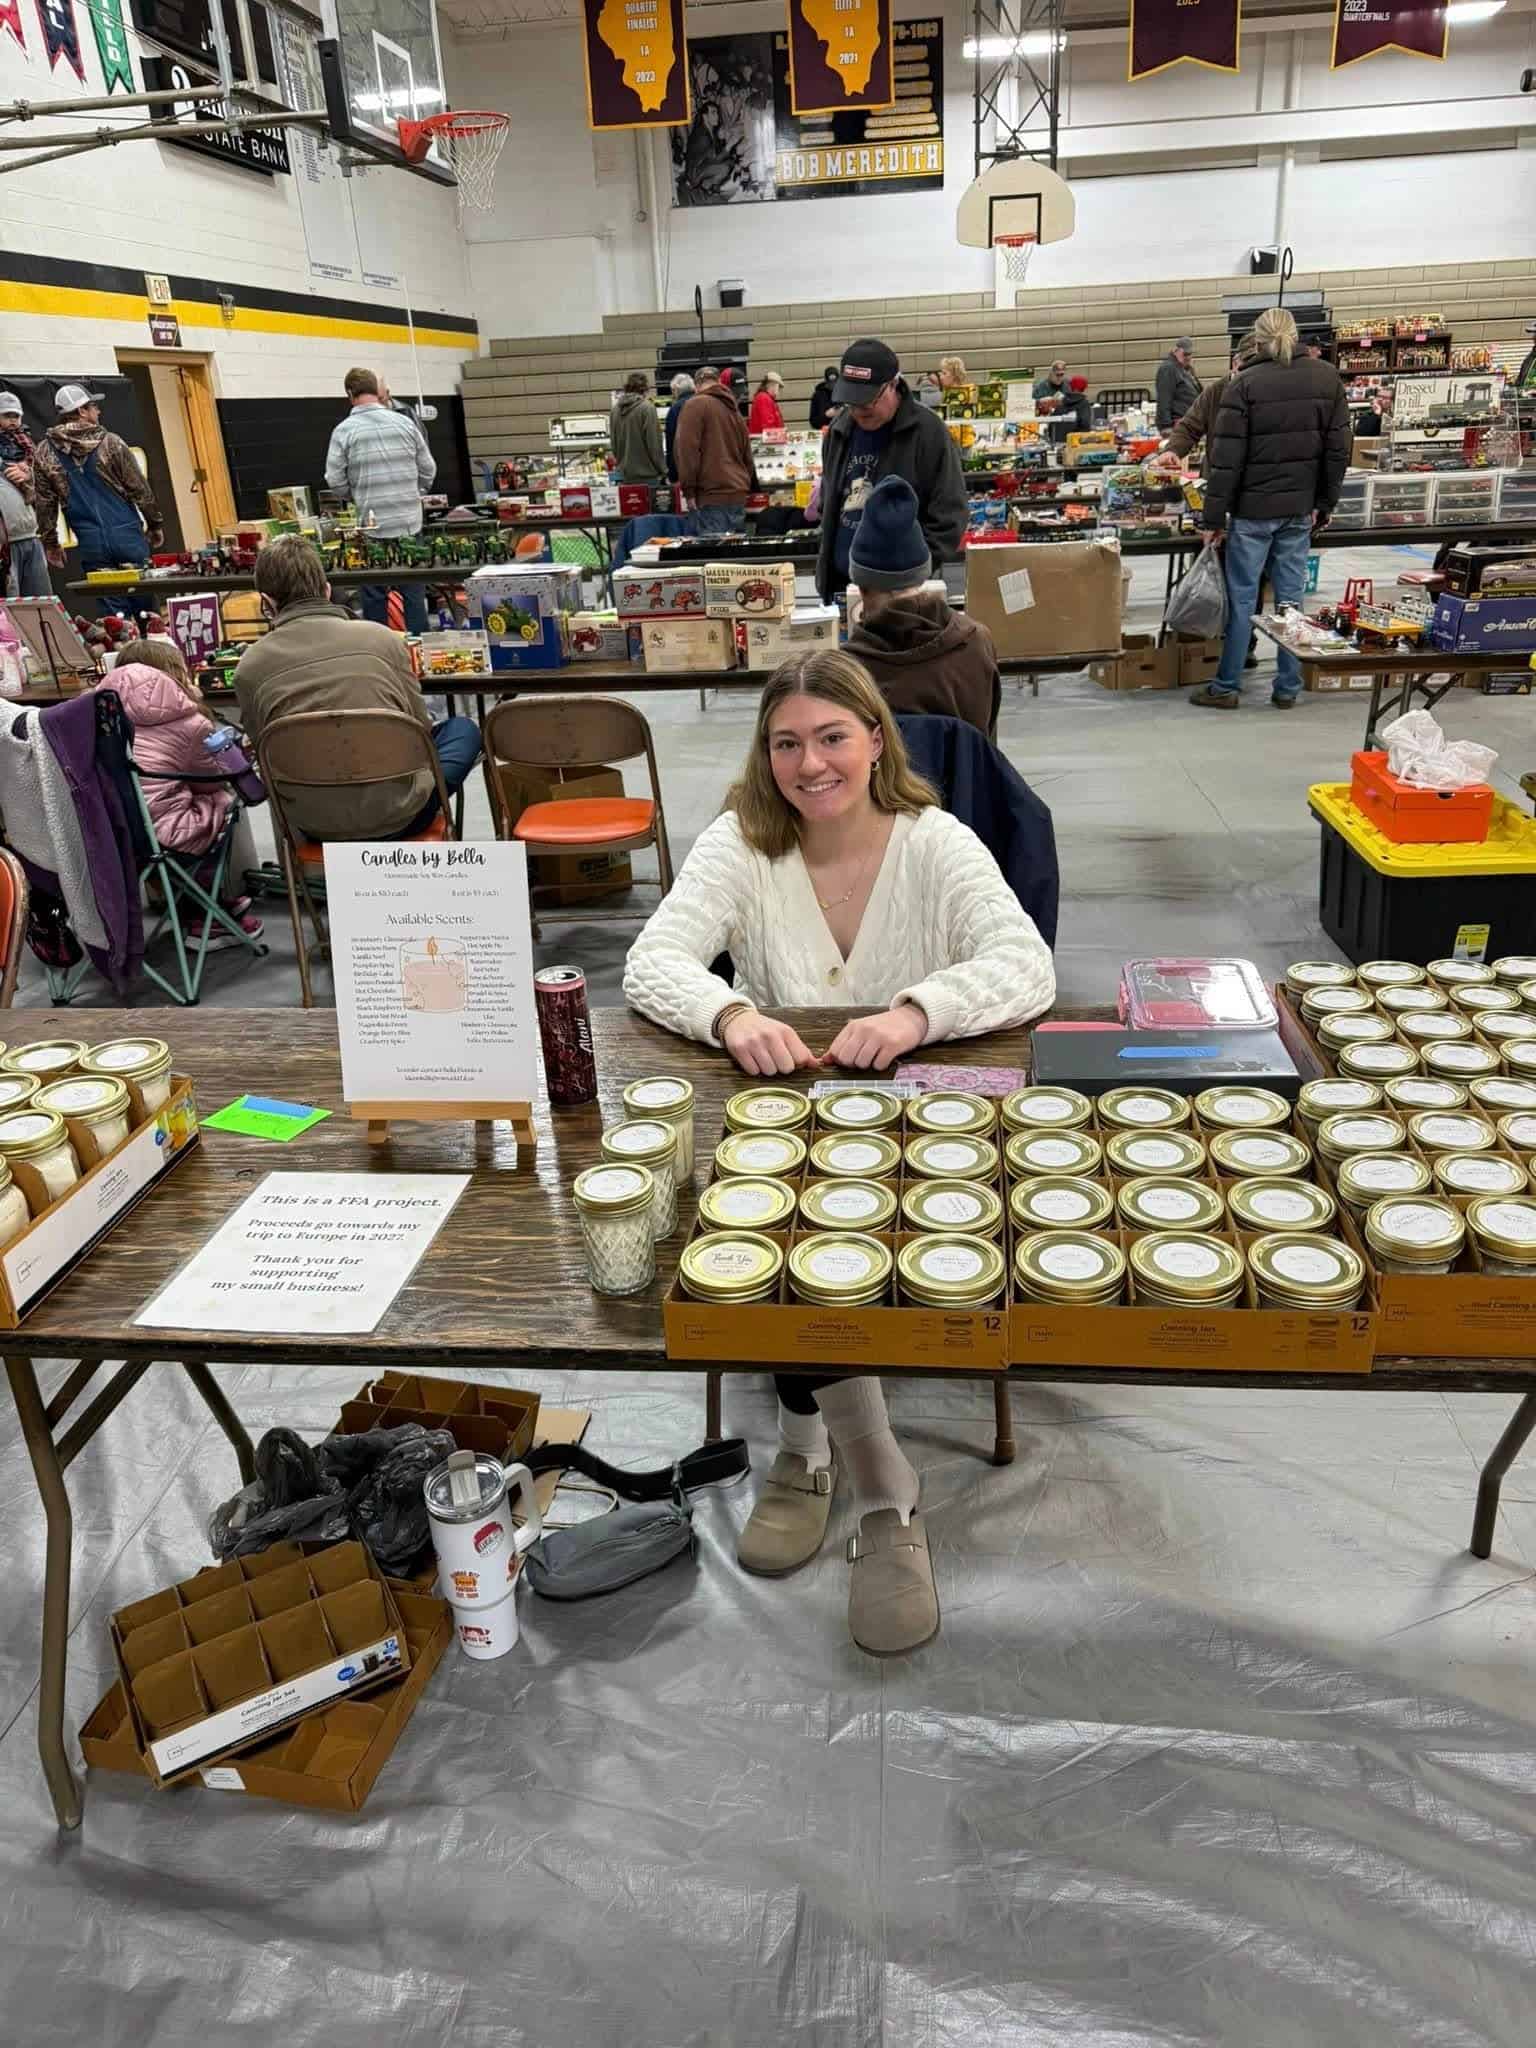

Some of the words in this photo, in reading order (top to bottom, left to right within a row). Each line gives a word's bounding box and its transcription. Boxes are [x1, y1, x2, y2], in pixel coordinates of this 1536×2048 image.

[624, 1, 658, 14] QUARTER
[1344, 0, 1368, 11] 2023
[1343, 11, 1391, 22] QUARTERFINALS
[626, 18, 658, 30] FINALIST
[250, 137, 289, 169] BANK
[782, 152, 820, 181] BOB
[826, 144, 939, 178] MEREDITH
[361, 848, 418, 866] Candles
[422, 849, 442, 868] by
[446, 848, 487, 866] Bella
[385, 914, 433, 925] Available
[262, 1195, 299, 1205] This
[301, 1196, 318, 1205] is
[337, 1196, 370, 1206] FFA
[372, 1197, 442, 1208] project.
[248, 1219, 314, 1229] Proceeds
[315, 1222, 334, 1231] go
[336, 1220, 395, 1230] towards
[397, 1223, 421, 1232] my
[245, 1230, 274, 1242] trip
[277, 1232, 293, 1240] to
[295, 1232, 348, 1242] Europe
[351, 1232, 366, 1241] in
[252, 1254, 302, 1265] Thank
[304, 1257, 335, 1267] you
[337, 1256, 364, 1266] for
[712, 1254, 734, 1262] Thank
[248, 1269, 342, 1281] supporting
[210, 1282, 238, 1292] my
[239, 1280, 284, 1291] small
[286, 1281, 365, 1292] business!
[983, 1316, 1001, 1330] 12
[1350, 1317, 1370, 1330] 12
